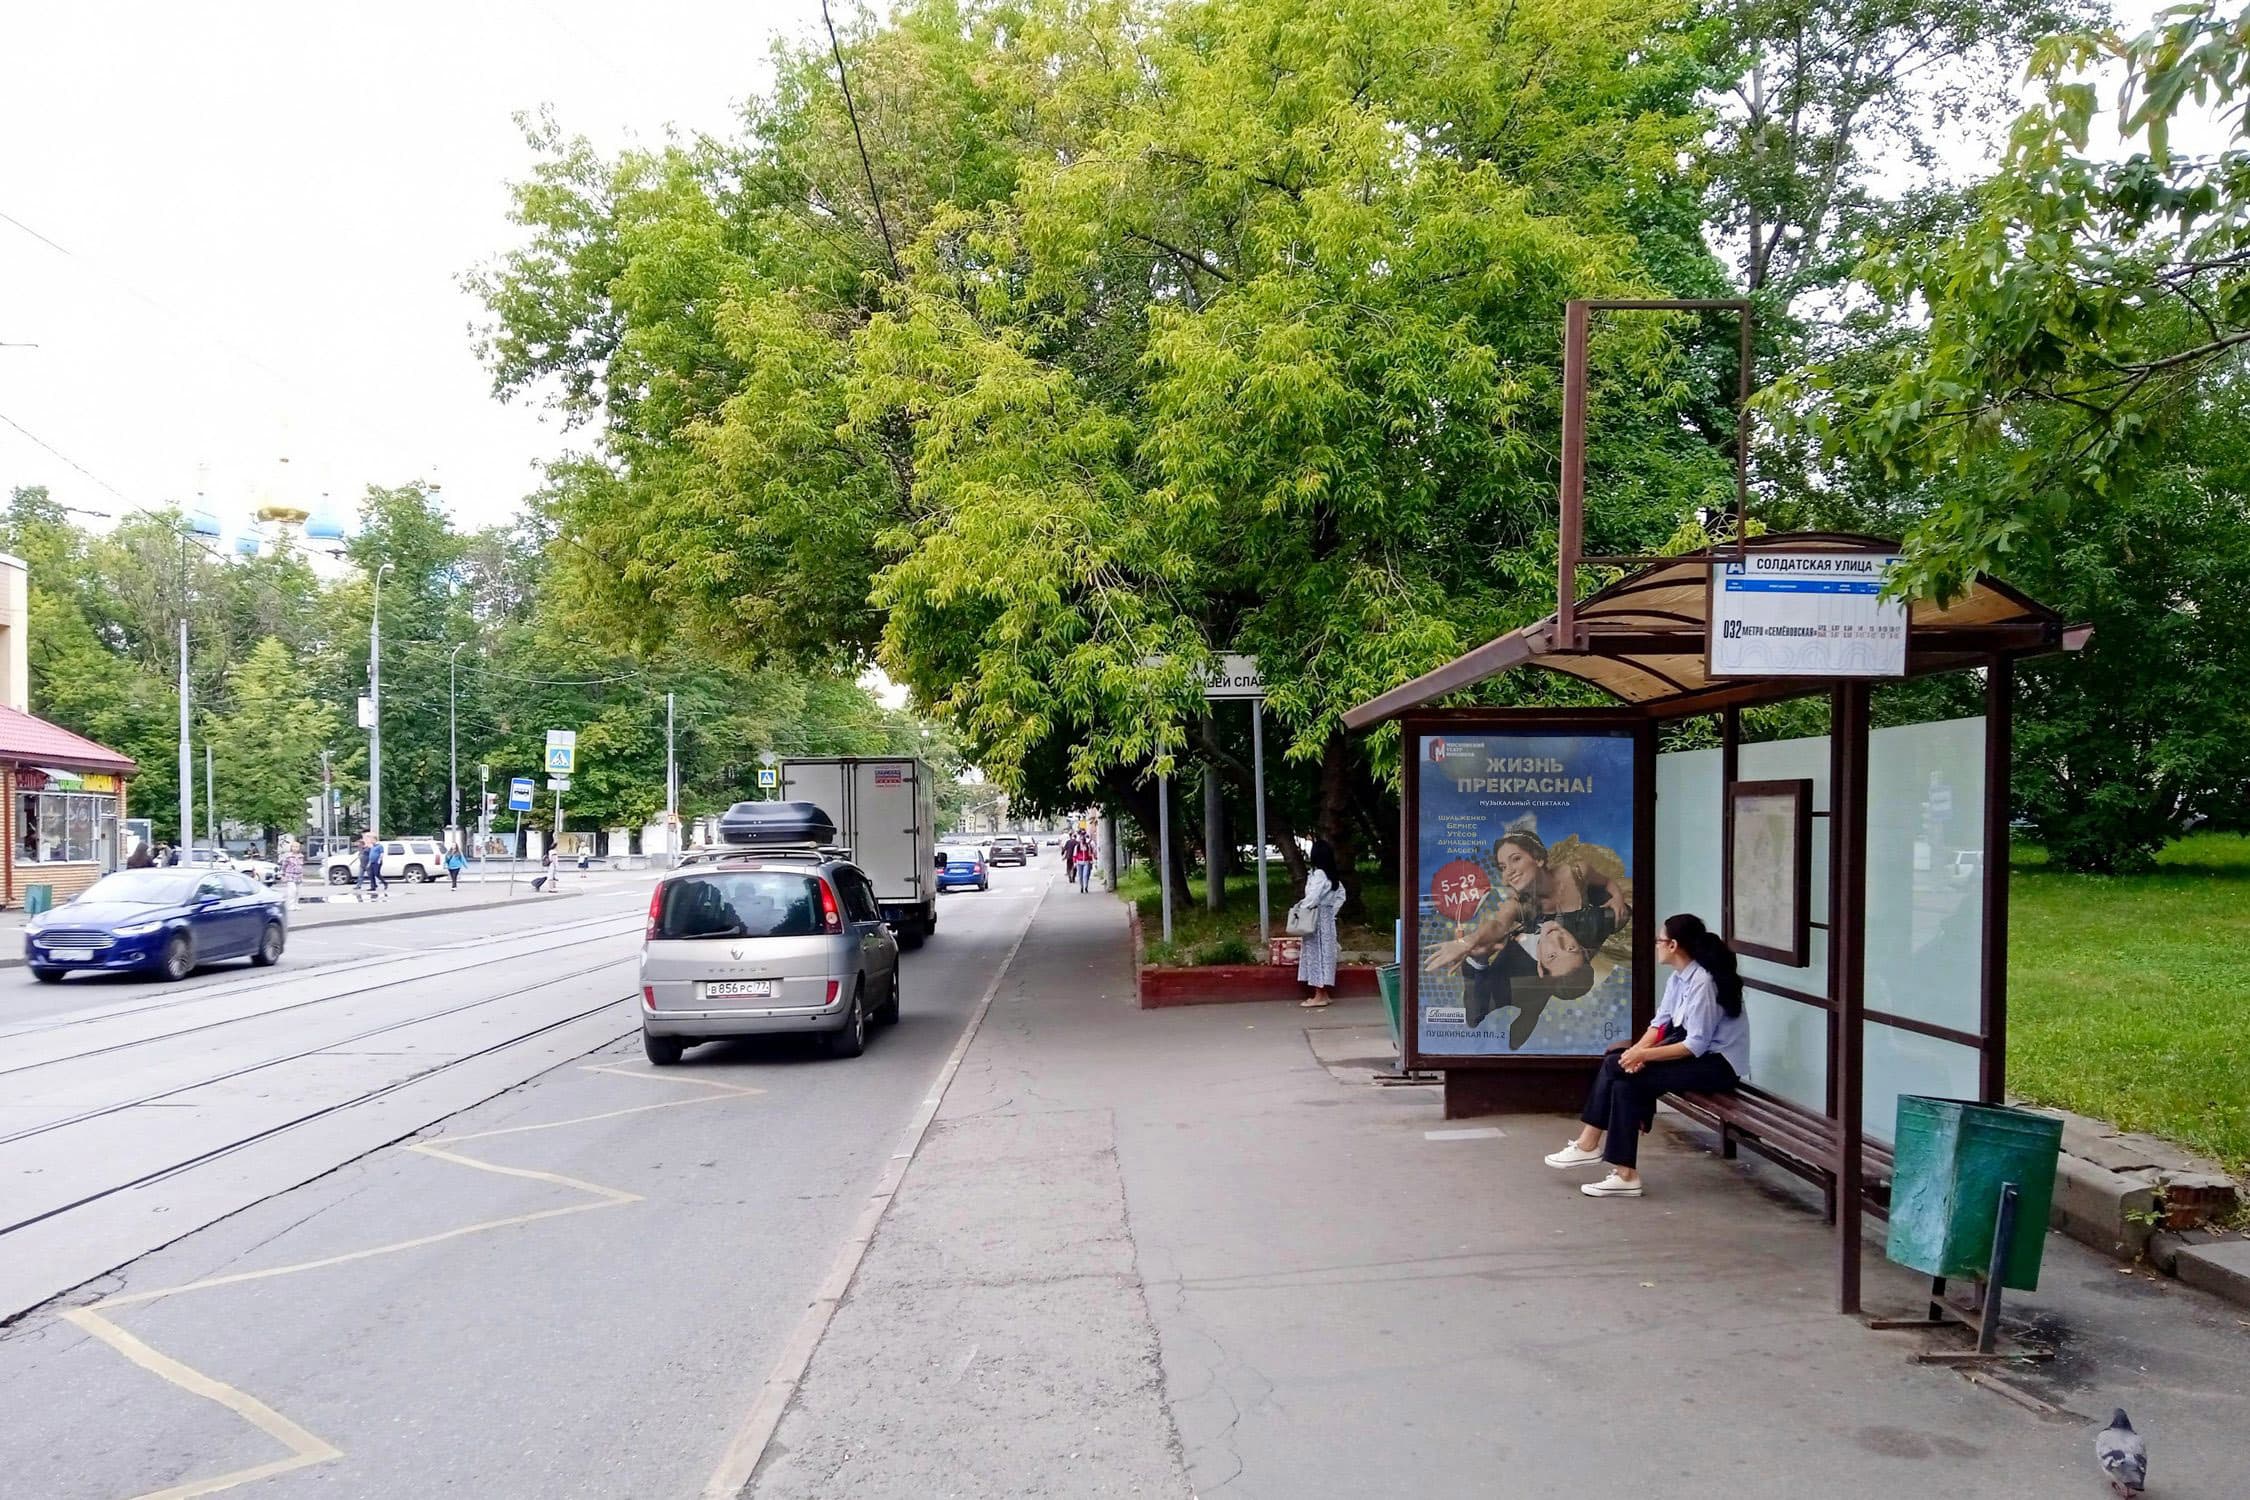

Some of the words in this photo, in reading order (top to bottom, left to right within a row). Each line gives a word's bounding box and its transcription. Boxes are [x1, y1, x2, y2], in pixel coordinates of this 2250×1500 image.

[1757, 558, 1831, 571] СОЛДАТСКАЯ
[1835, 560, 1872, 572] УЛИЦА
[1723, 620, 1742, 639] 032
[1742, 626, 1764, 636] МЕТРО
[1487, 758, 1564, 773] ЖИЗНЬ
[1457, 776, 1593, 793] ПРЕКРАСНА!
[1444, 888, 1480, 907] МАЯ
[1426, 1030, 1482, 1038] ПУШКИНСКАЯ
[1604, 1021, 1623, 1040] 6+
